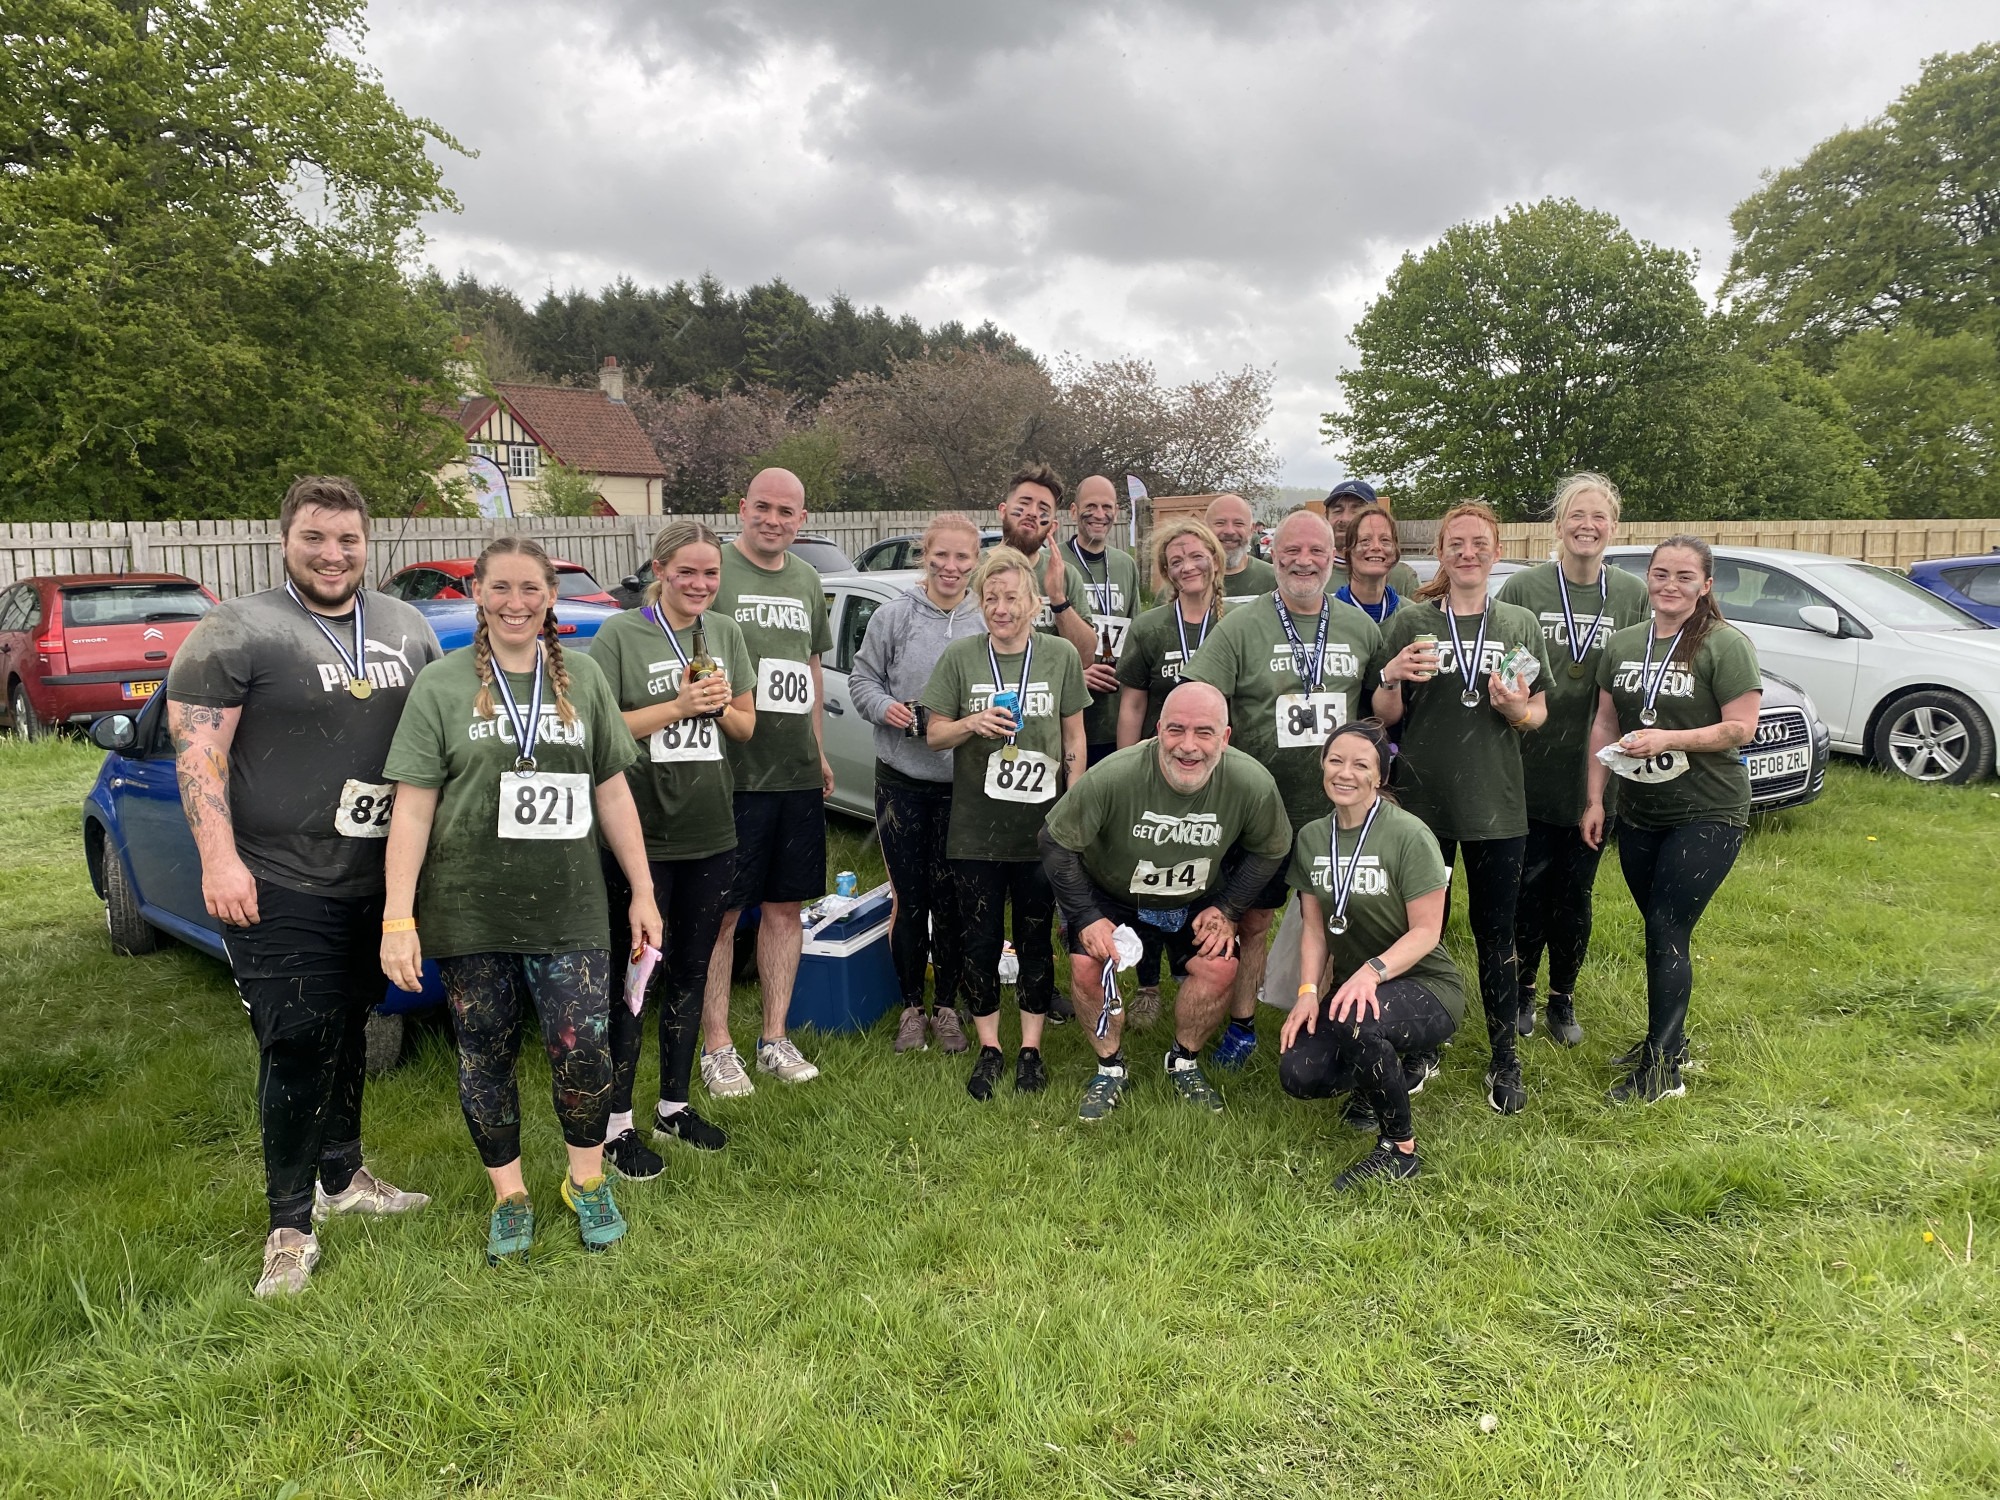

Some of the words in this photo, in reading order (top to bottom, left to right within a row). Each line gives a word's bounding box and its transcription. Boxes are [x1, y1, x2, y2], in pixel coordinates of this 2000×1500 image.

[735, 606, 756, 622] GET
[756, 603, 812, 636] CAKED!
[1279, 608, 1288, 621] TYNE
[1286, 627, 1294, 640] PORT
[1542, 625, 1554, 639] ET
[1554, 621, 1617, 650] CKED
[1161, 662, 1180, 678] GET
[1270, 656, 1291, 672] GET
[1291, 652, 1359, 679] CKED!
[1438, 649, 1508, 675] CAED
[647, 676, 671, 696] GET
[768, 669, 808, 704] 808
[467, 720, 495, 741] GET
[1288, 703, 1337, 736] 815
[996, 759, 1046, 793] 822
[1633, 752, 1674, 775] 16
[1750, 755, 1784, 777] BF08
[1786, 751, 1807, 770] ZRL
[350, 794, 394, 827] 82
[514, 785, 574, 825] 821
[1132, 824, 1156, 840] GET
[1153, 821, 1223, 847] CAKED!
